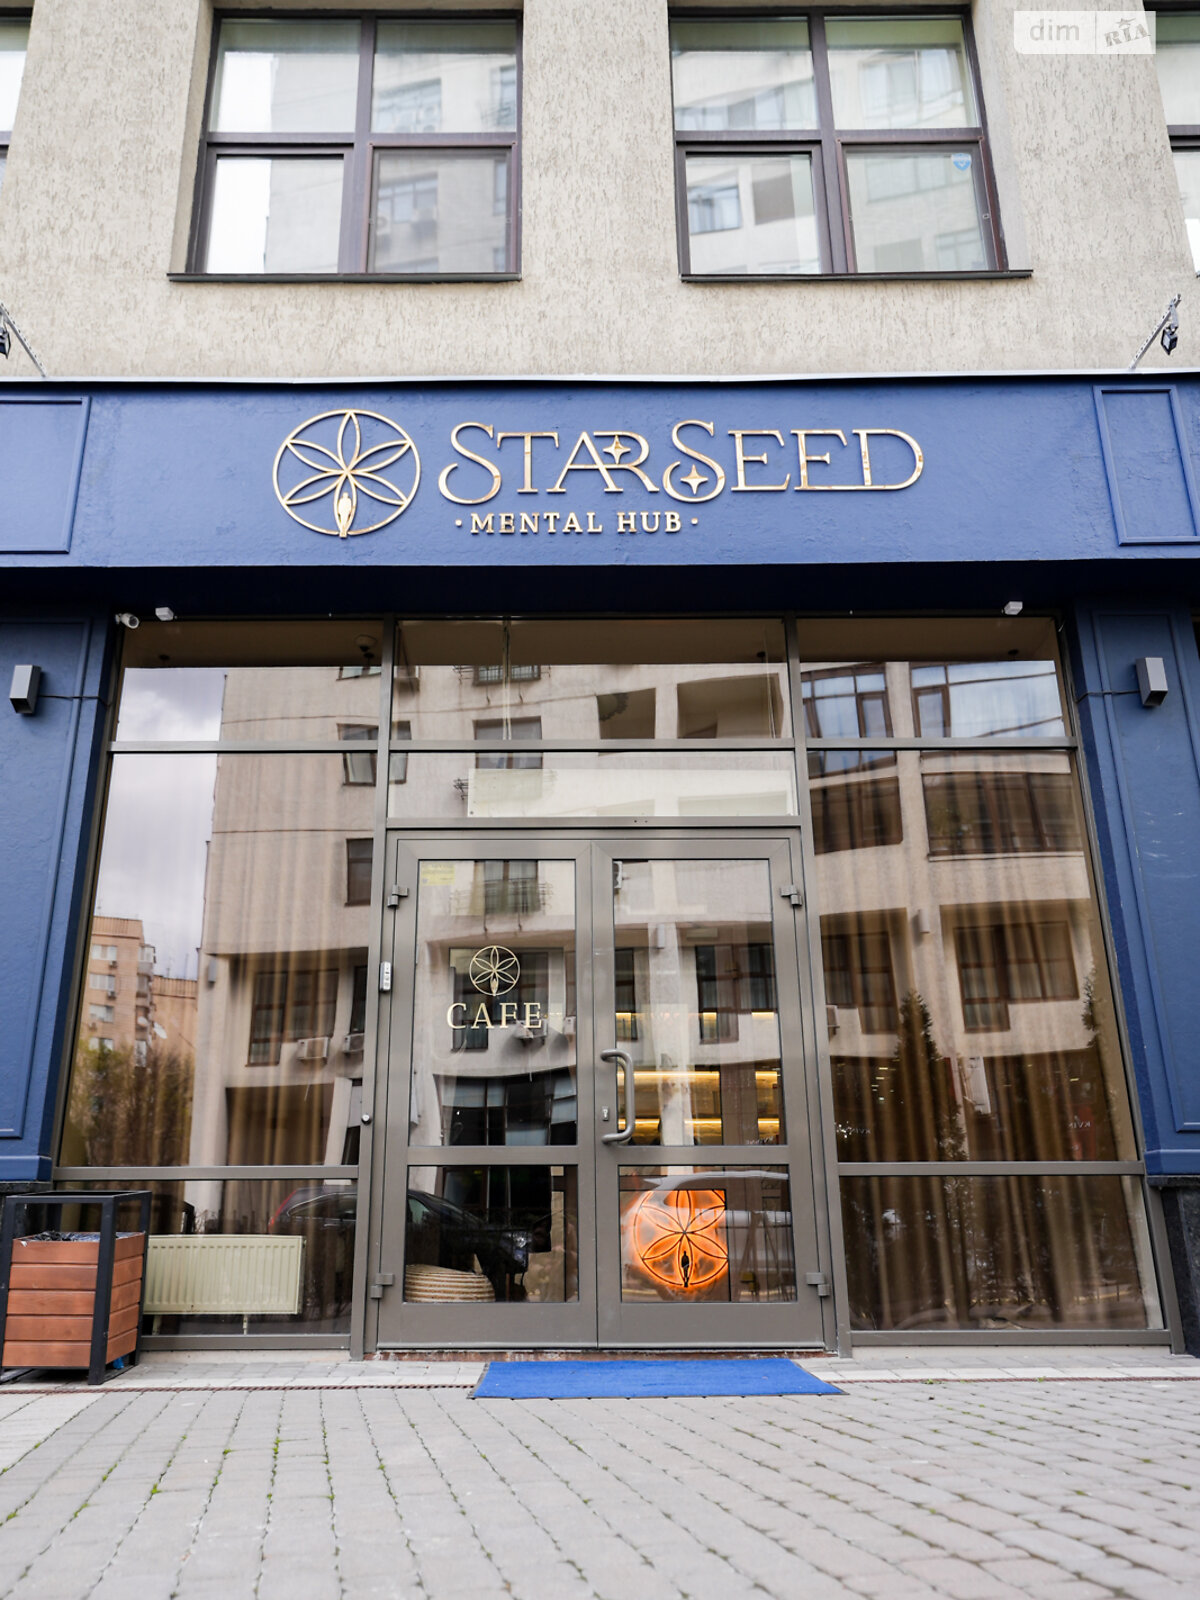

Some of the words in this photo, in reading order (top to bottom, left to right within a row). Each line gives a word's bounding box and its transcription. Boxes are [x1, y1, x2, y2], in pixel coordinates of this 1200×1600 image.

[438, 419, 924, 505] STARSEED
[470, 512, 603, 534] MENTAL
[617, 511, 682, 533] HUB
[446, 1002, 542, 1029] CAFE
